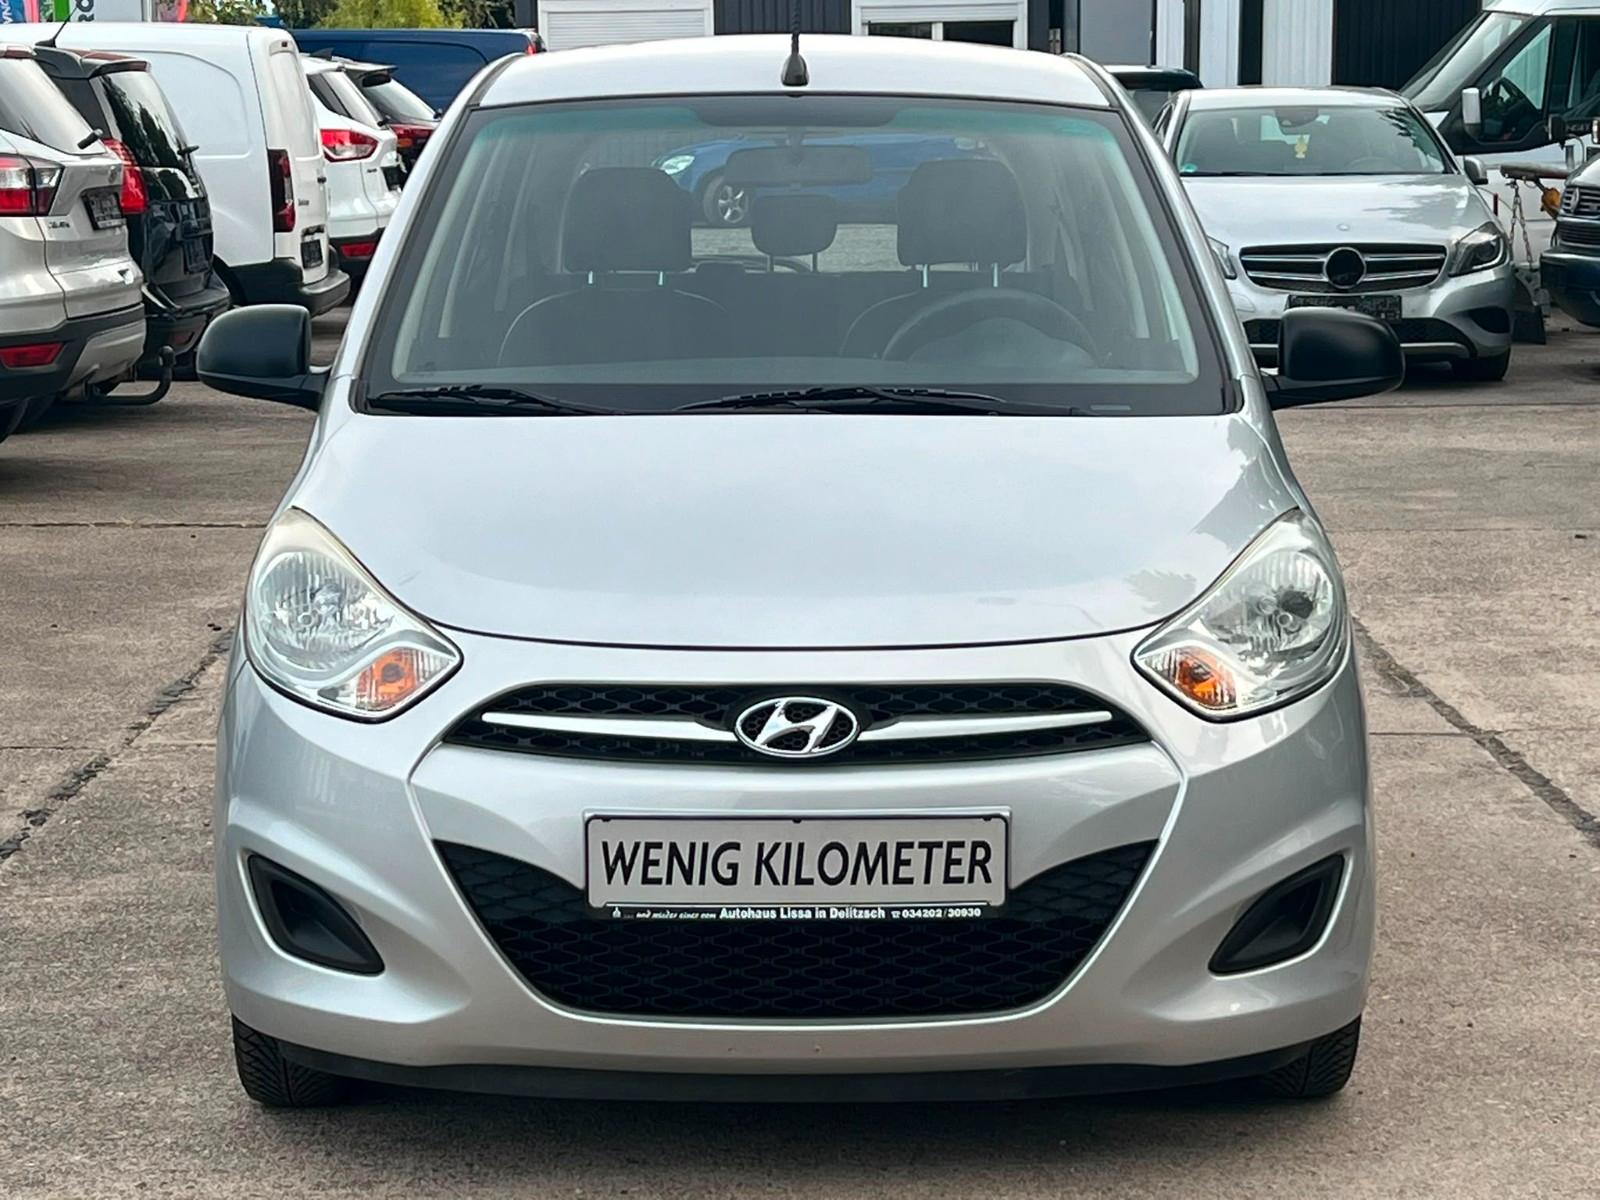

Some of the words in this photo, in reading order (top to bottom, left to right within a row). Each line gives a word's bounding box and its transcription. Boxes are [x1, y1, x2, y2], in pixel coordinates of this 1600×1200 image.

[602, 841, 741, 886] WENIG
[754, 840, 993, 886] KILOMETER
[719, 906, 777, 919] Autohaus
[780, 906, 812, 919] Lissa
[815, 906, 827, 919] in
[829, 906, 886, 919] Delitzsch
